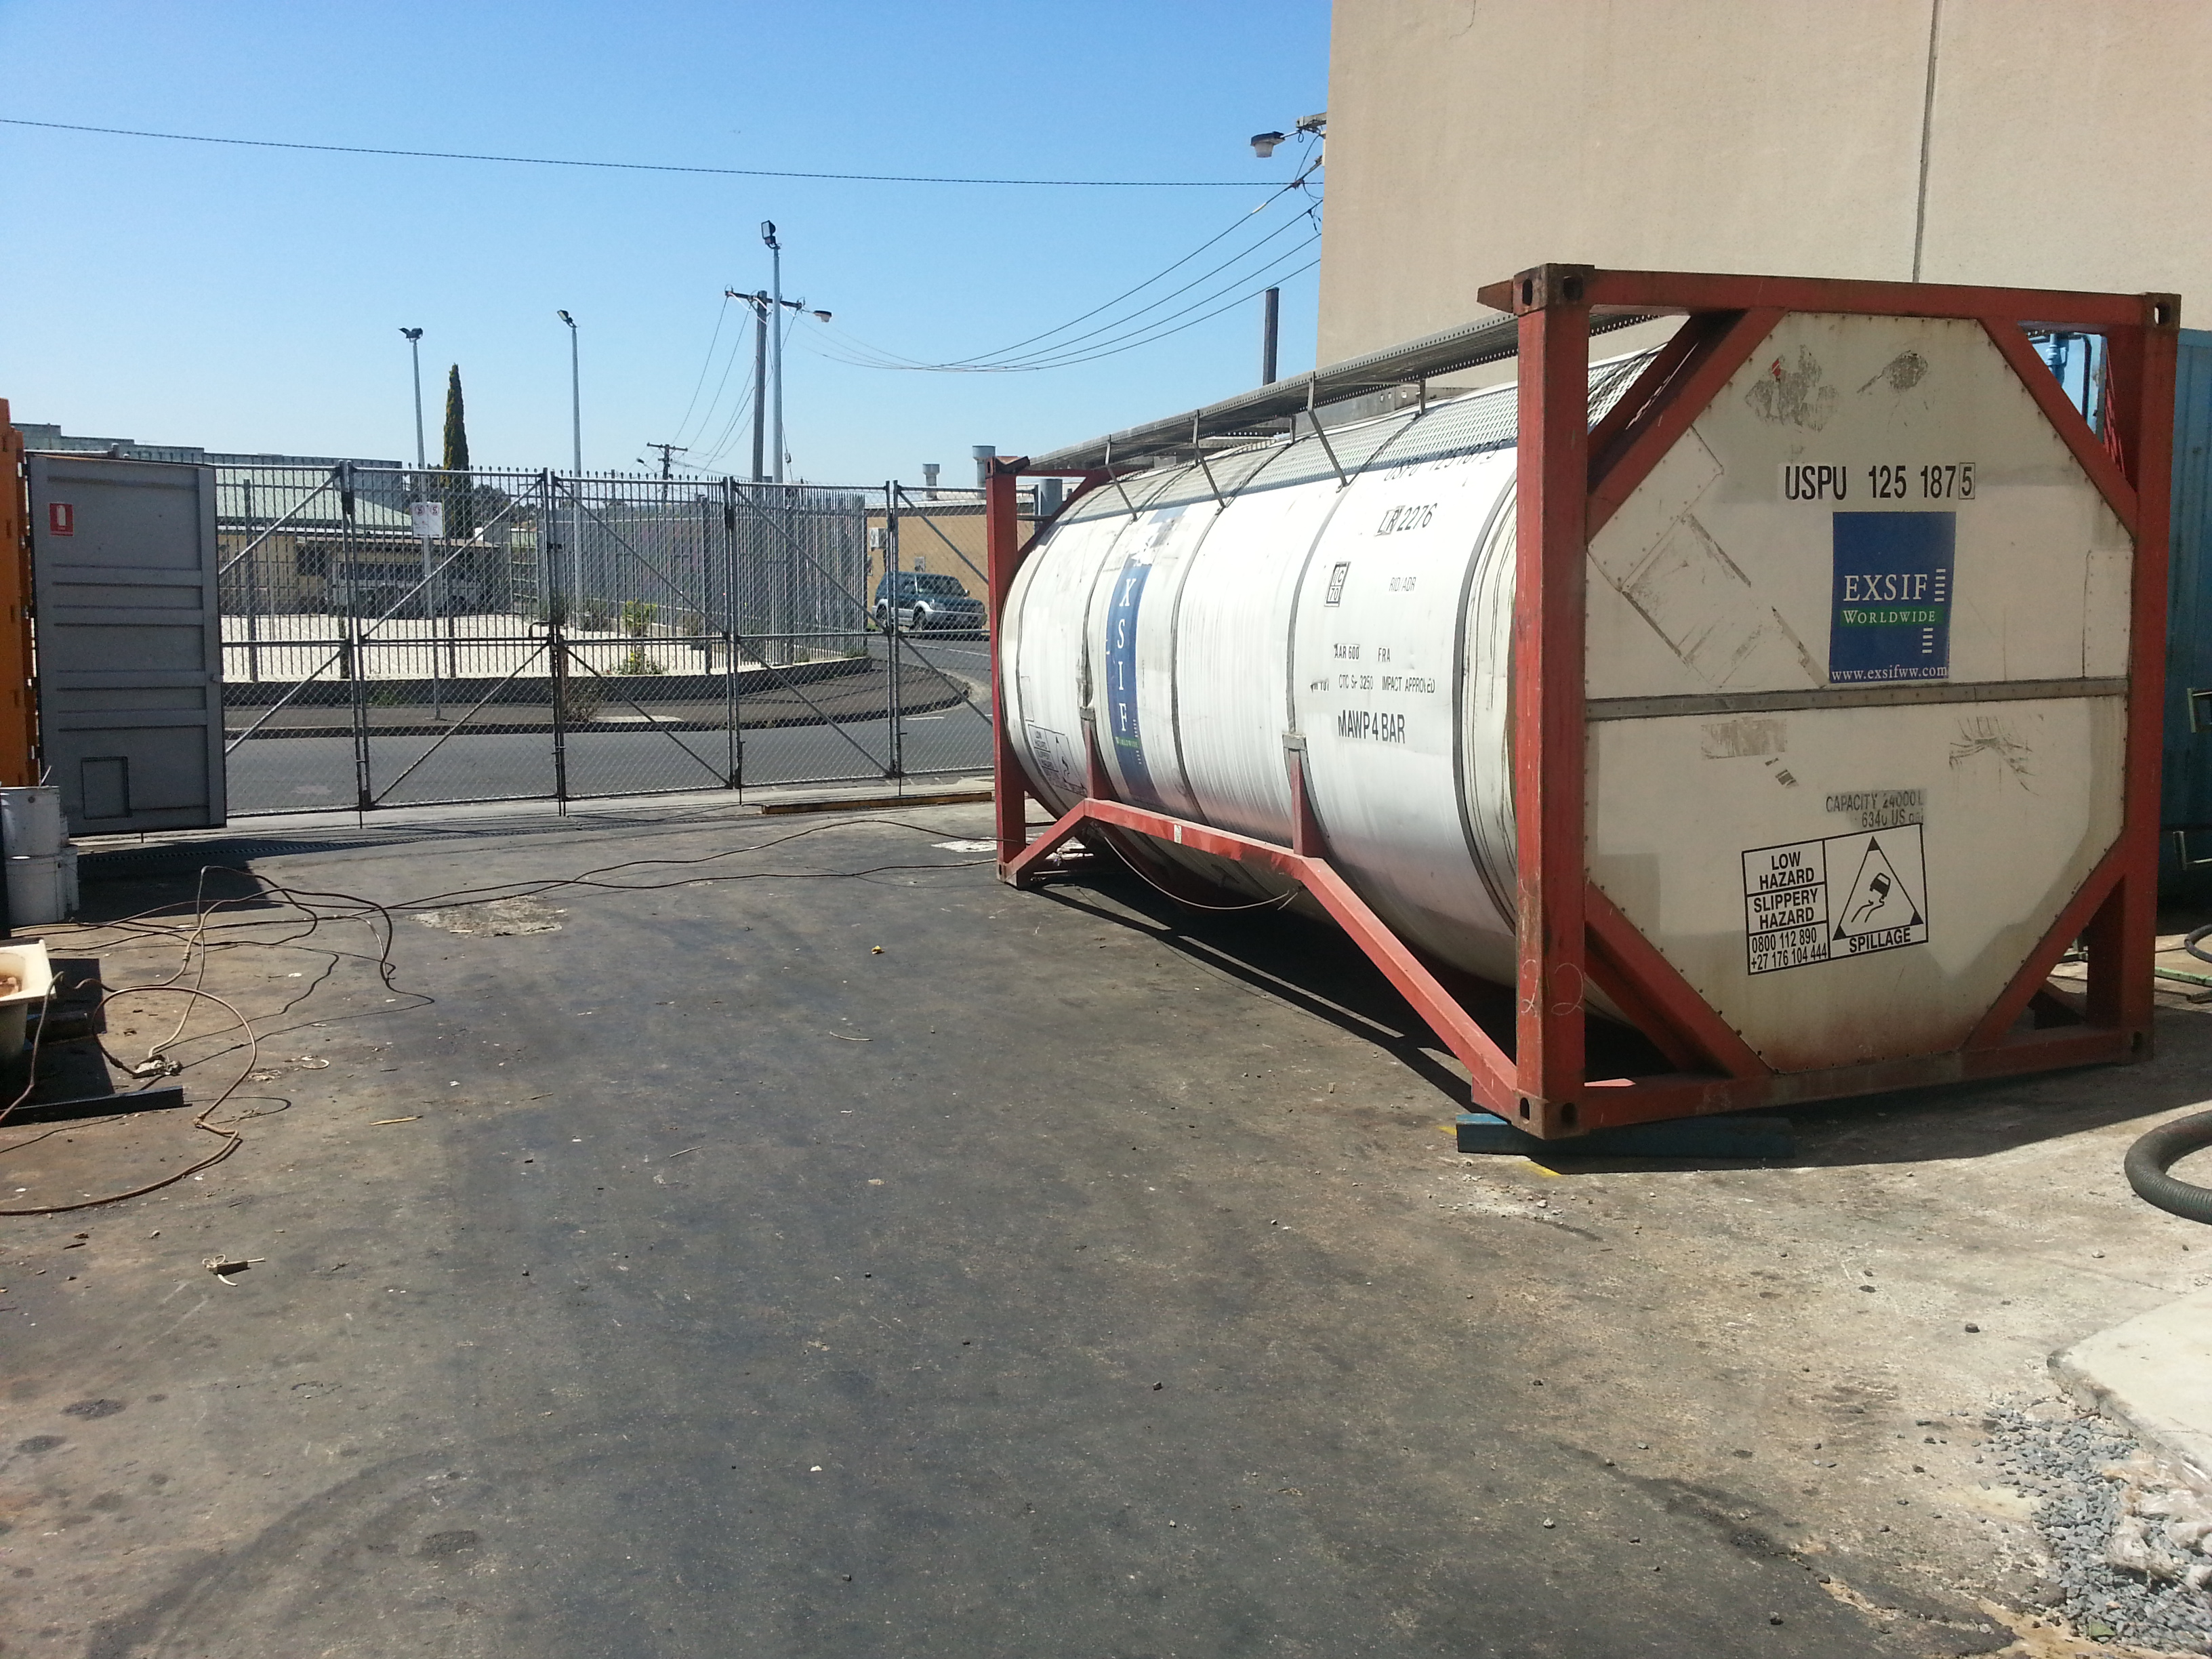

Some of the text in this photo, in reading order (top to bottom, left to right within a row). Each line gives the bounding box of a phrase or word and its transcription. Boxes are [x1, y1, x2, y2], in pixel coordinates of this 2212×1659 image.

[1784, 466, 1847, 500] USPU
[1868, 465, 1907, 499] 125
[1330, 588, 1339, 601] 70
[1843, 574, 1928, 602] EXSIF
[1334, 646, 1359, 660] AAR 600
[1378, 647, 1391, 662] FRA
[1338, 674, 1349, 689] CTC
[1382, 676, 1403, 691] IMPACT
[1832, 665, 1948, 681] www.exsifww.com
[1338, 710, 1406, 744] MAWP 4 BAR
[1826, 793, 1878, 813] CAPACITY
[1882, 790, 1916, 808] 24000
[1891, 808, 1906, 825] US
[1771, 851, 1801, 870] LOW
[1759, 867, 1814, 890] HAZARD
[1753, 888, 1818, 913] SLIPPERY
[1759, 907, 1814, 930] HAZARD
[1752, 927, 1816, 954] 0800 112 890
[1849, 927, 1911, 954] SPILLAGE
[1751, 942, 1827, 970] +27 176 104 444
